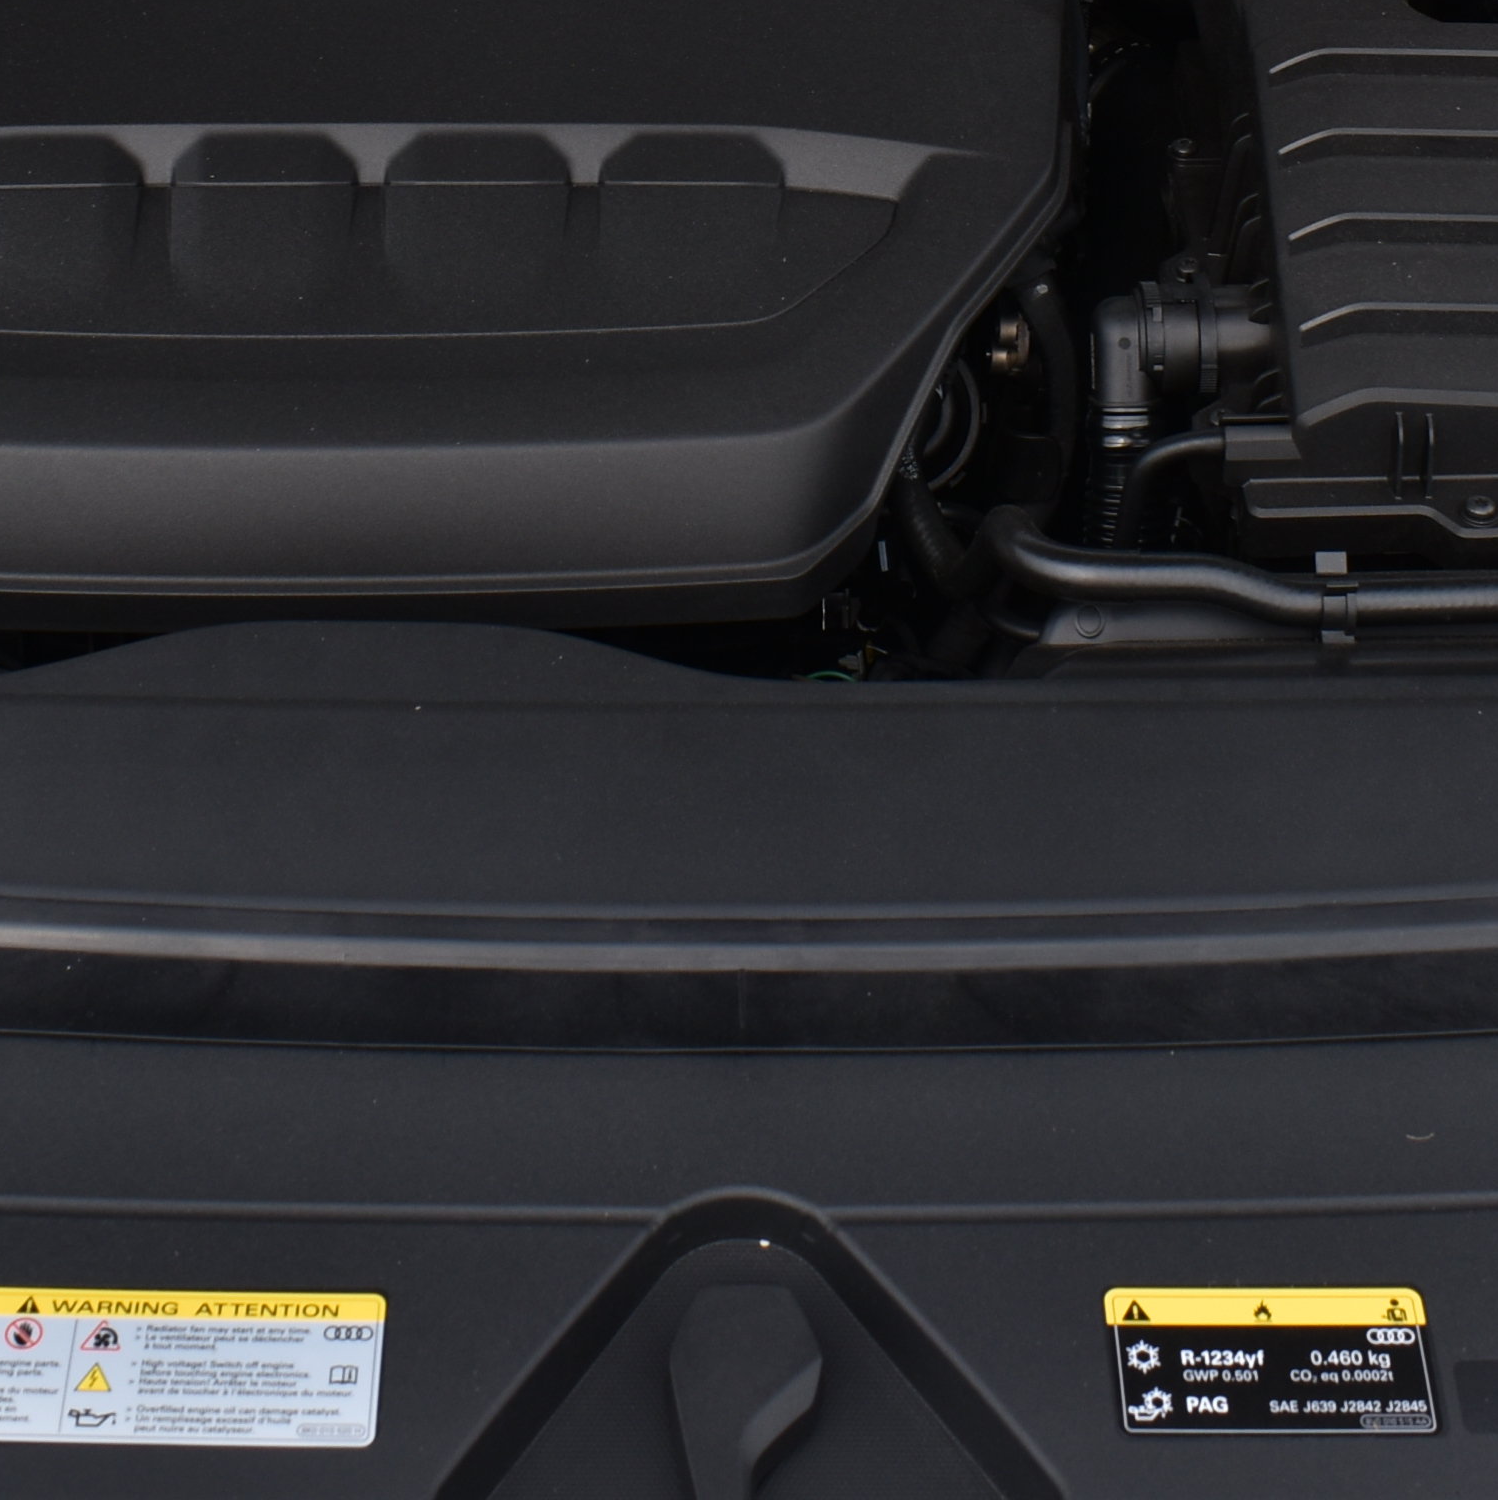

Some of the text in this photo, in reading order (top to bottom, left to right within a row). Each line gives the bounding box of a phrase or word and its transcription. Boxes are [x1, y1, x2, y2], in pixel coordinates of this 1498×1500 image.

[51, 1299, 341, 1319] WARNING ATTENTION
[146, 1324, 187, 1333] Radiator
[190, 1325, 205, 1333] fan
[208, 1326, 229, 1335] may
[232, 1326, 254, 1334] start
[268, 1327, 286, 1335] any
[210, 1360, 243, 1368] Switch
[1180, 1349, 1265, 1369] R-1234yf
[1310, 1349, 1391, 1369] 0.460 kg
[140, 1369, 172, 1377] before
[174, 1370, 217, 1379] touching
[220, 1371, 253, 1379] engine
[1182, 1368, 1259, 1382] GWP 0.501
[1320, 1371, 1339, 1384] eq
[1341, 1369, 1394, 1382] 0.0002t
[7, 1386, 21, 1395] du
[22, 1387, 60, 1395] moteur
[182, 1388, 219, 1396] toucher
[1185, 1395, 1229, 1413] PAG
[1269, 1399, 1428, 1413] SAE J639 J2842 J2845
[258, 1407, 298, 1417] damage
